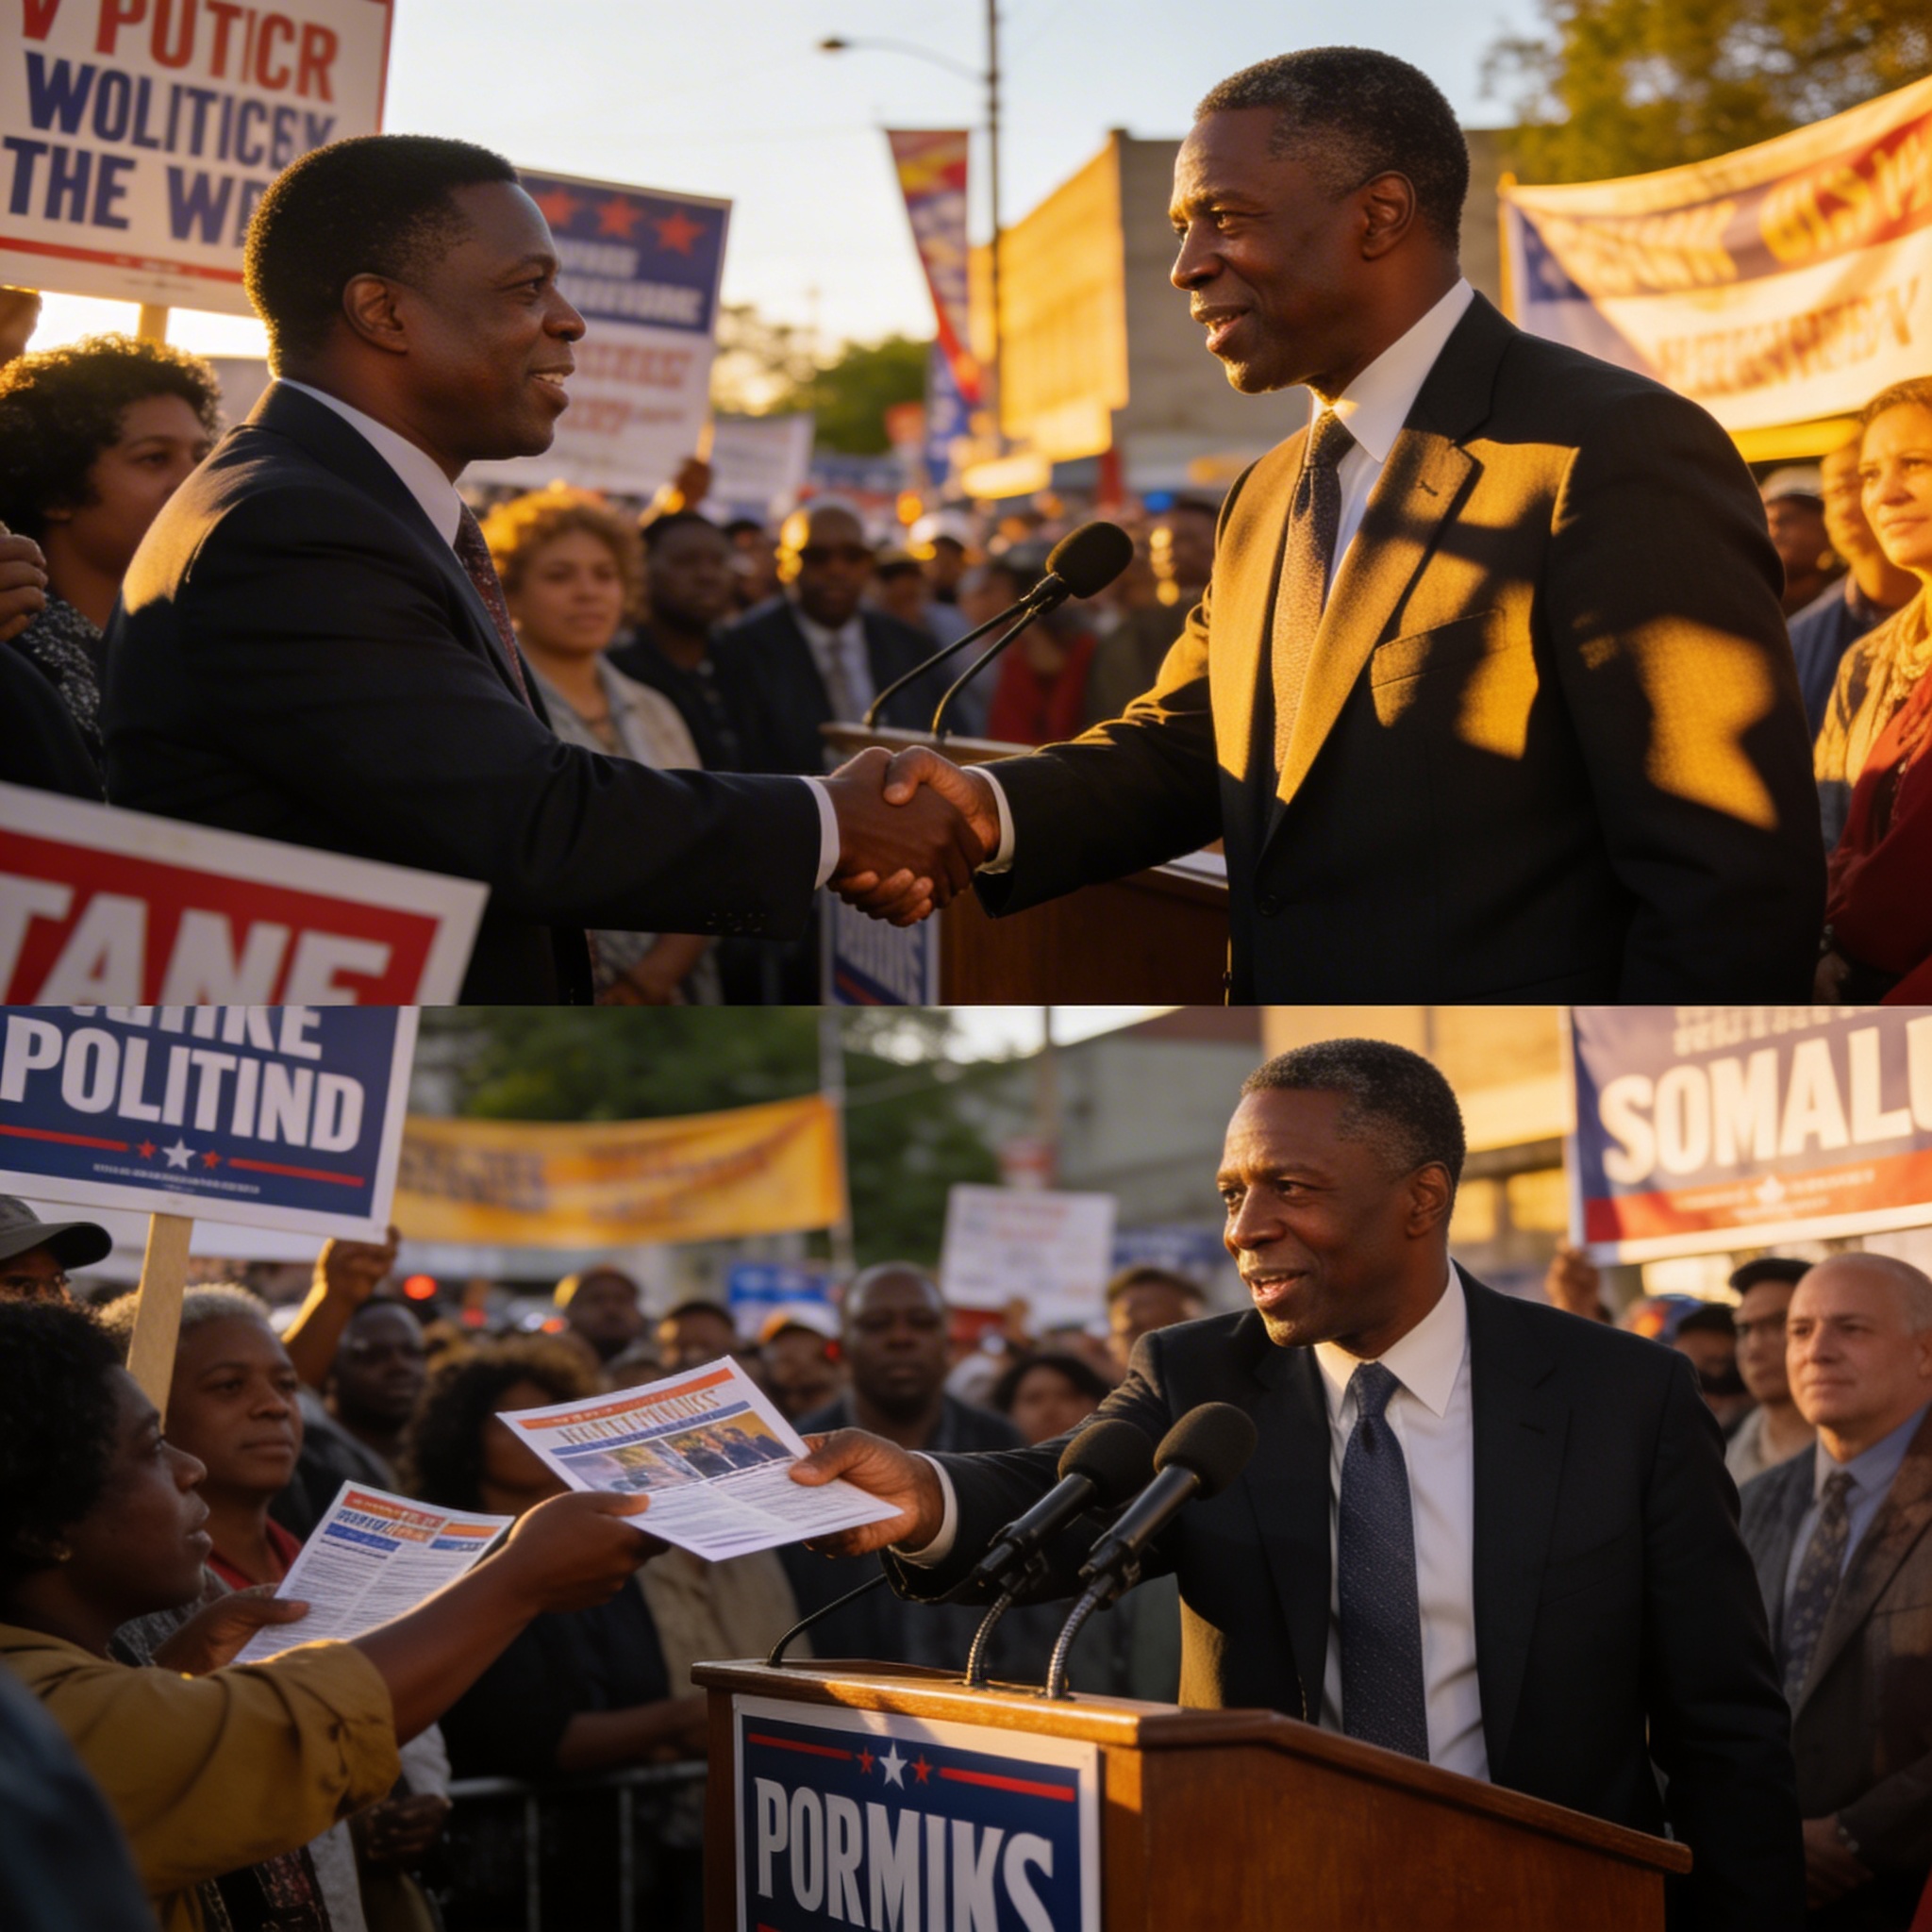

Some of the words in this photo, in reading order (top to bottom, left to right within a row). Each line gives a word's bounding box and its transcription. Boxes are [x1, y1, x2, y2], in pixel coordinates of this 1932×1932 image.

[3, 135, 137, 230] THE
[0, 1014, 365, 1154] POLITIND
[755, 1776, 1056, 1932] PORMIKS
